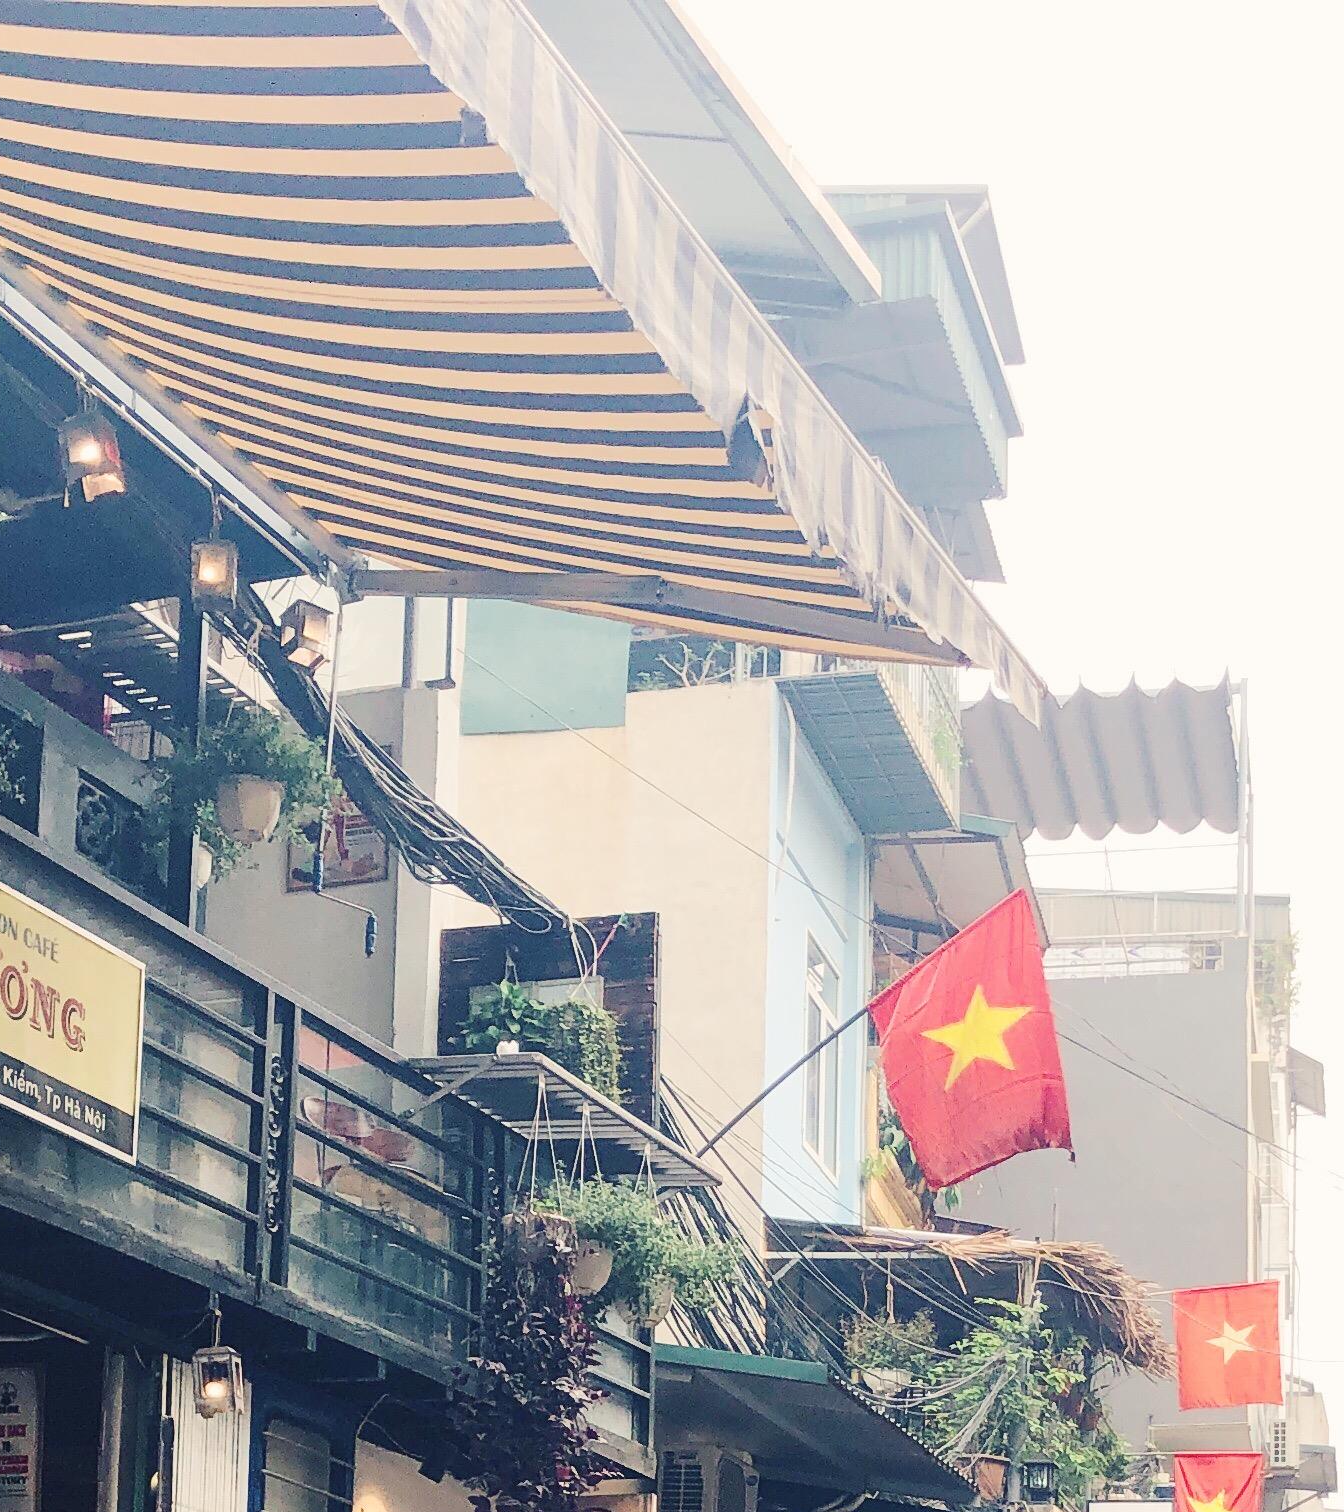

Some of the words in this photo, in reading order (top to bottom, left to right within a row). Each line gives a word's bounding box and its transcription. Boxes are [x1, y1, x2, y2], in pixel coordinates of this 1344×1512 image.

[44, 1084, 62, 1113] Tp
[64, 1094, 81, 1120] Hà
[84, 1104, 107, 1133] Nội
